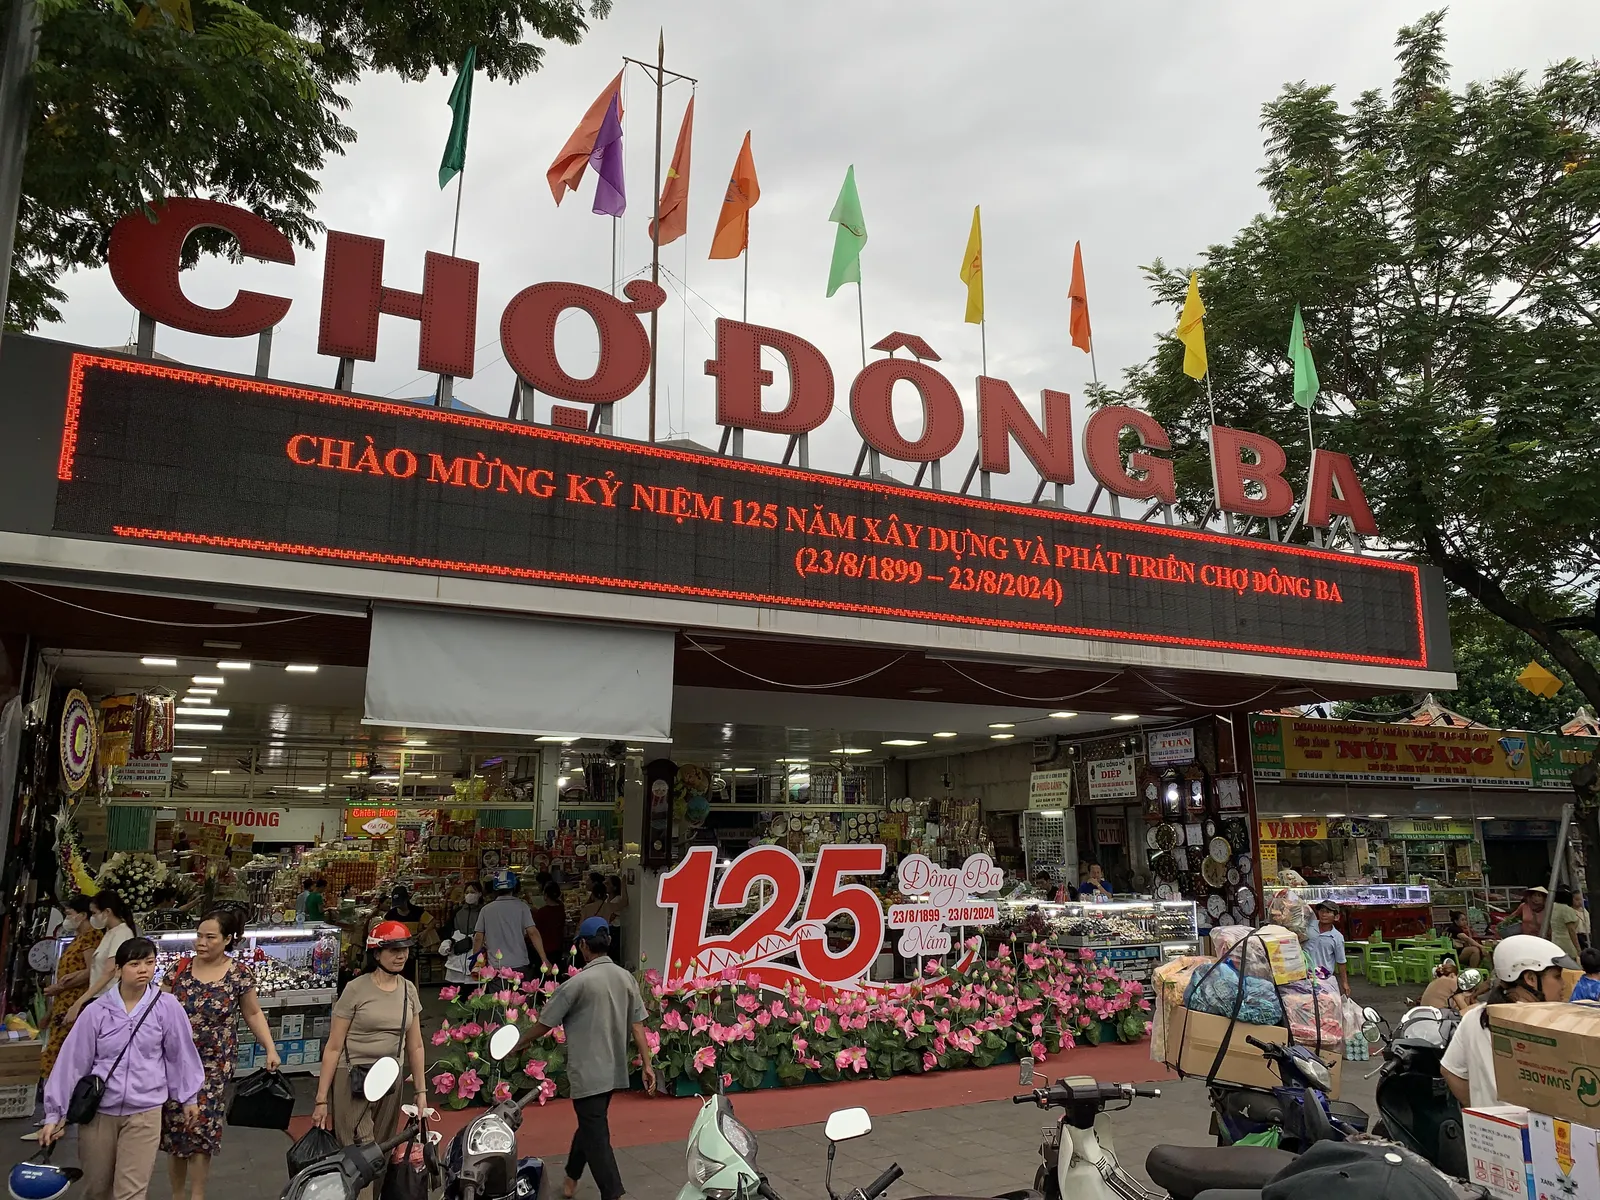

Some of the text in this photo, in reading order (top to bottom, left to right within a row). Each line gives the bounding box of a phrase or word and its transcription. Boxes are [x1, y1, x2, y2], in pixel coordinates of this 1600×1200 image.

[108, 196, 1379, 536] CHỢ ĐÔNG BA
[286, 434, 418, 478] CHÀO
[427, 452, 556, 498] MỪNG
[565, 470, 623, 507] KỶ
[630, 484, 724, 524] NIỆM
[732, 499, 778, 529] 125
[785, 503, 856, 541] NĂM
[863, 513, 923, 549] XÂY
[928, 526, 1009, 560] DỰNG
[1012, 535, 1051, 567] VÀ
[1054, 544, 1122, 575] PHÁT
[1200, 564, 1249, 596] CHỢ
[1252, 567, 1311, 599] ĐÔNG
[1314, 579, 1343, 603] BA
[795, 547, 923, 584] (23/8/1899
[948, 565, 1063, 608] 23/8/2024)
[1335, 737, 1494, 766] NÚI VÀNG
[1101, 767, 1121, 780] DIỆP
[903, 859, 1000, 908] Đông Ba
[658, 844, 886, 988] 125
[893, 908, 940, 923] 23/8/1899
[948, 906, 995, 921] 23/8/2024
[903, 924, 948, 952] Năm
[1518, 1067, 1572, 1091] SUWADEE
